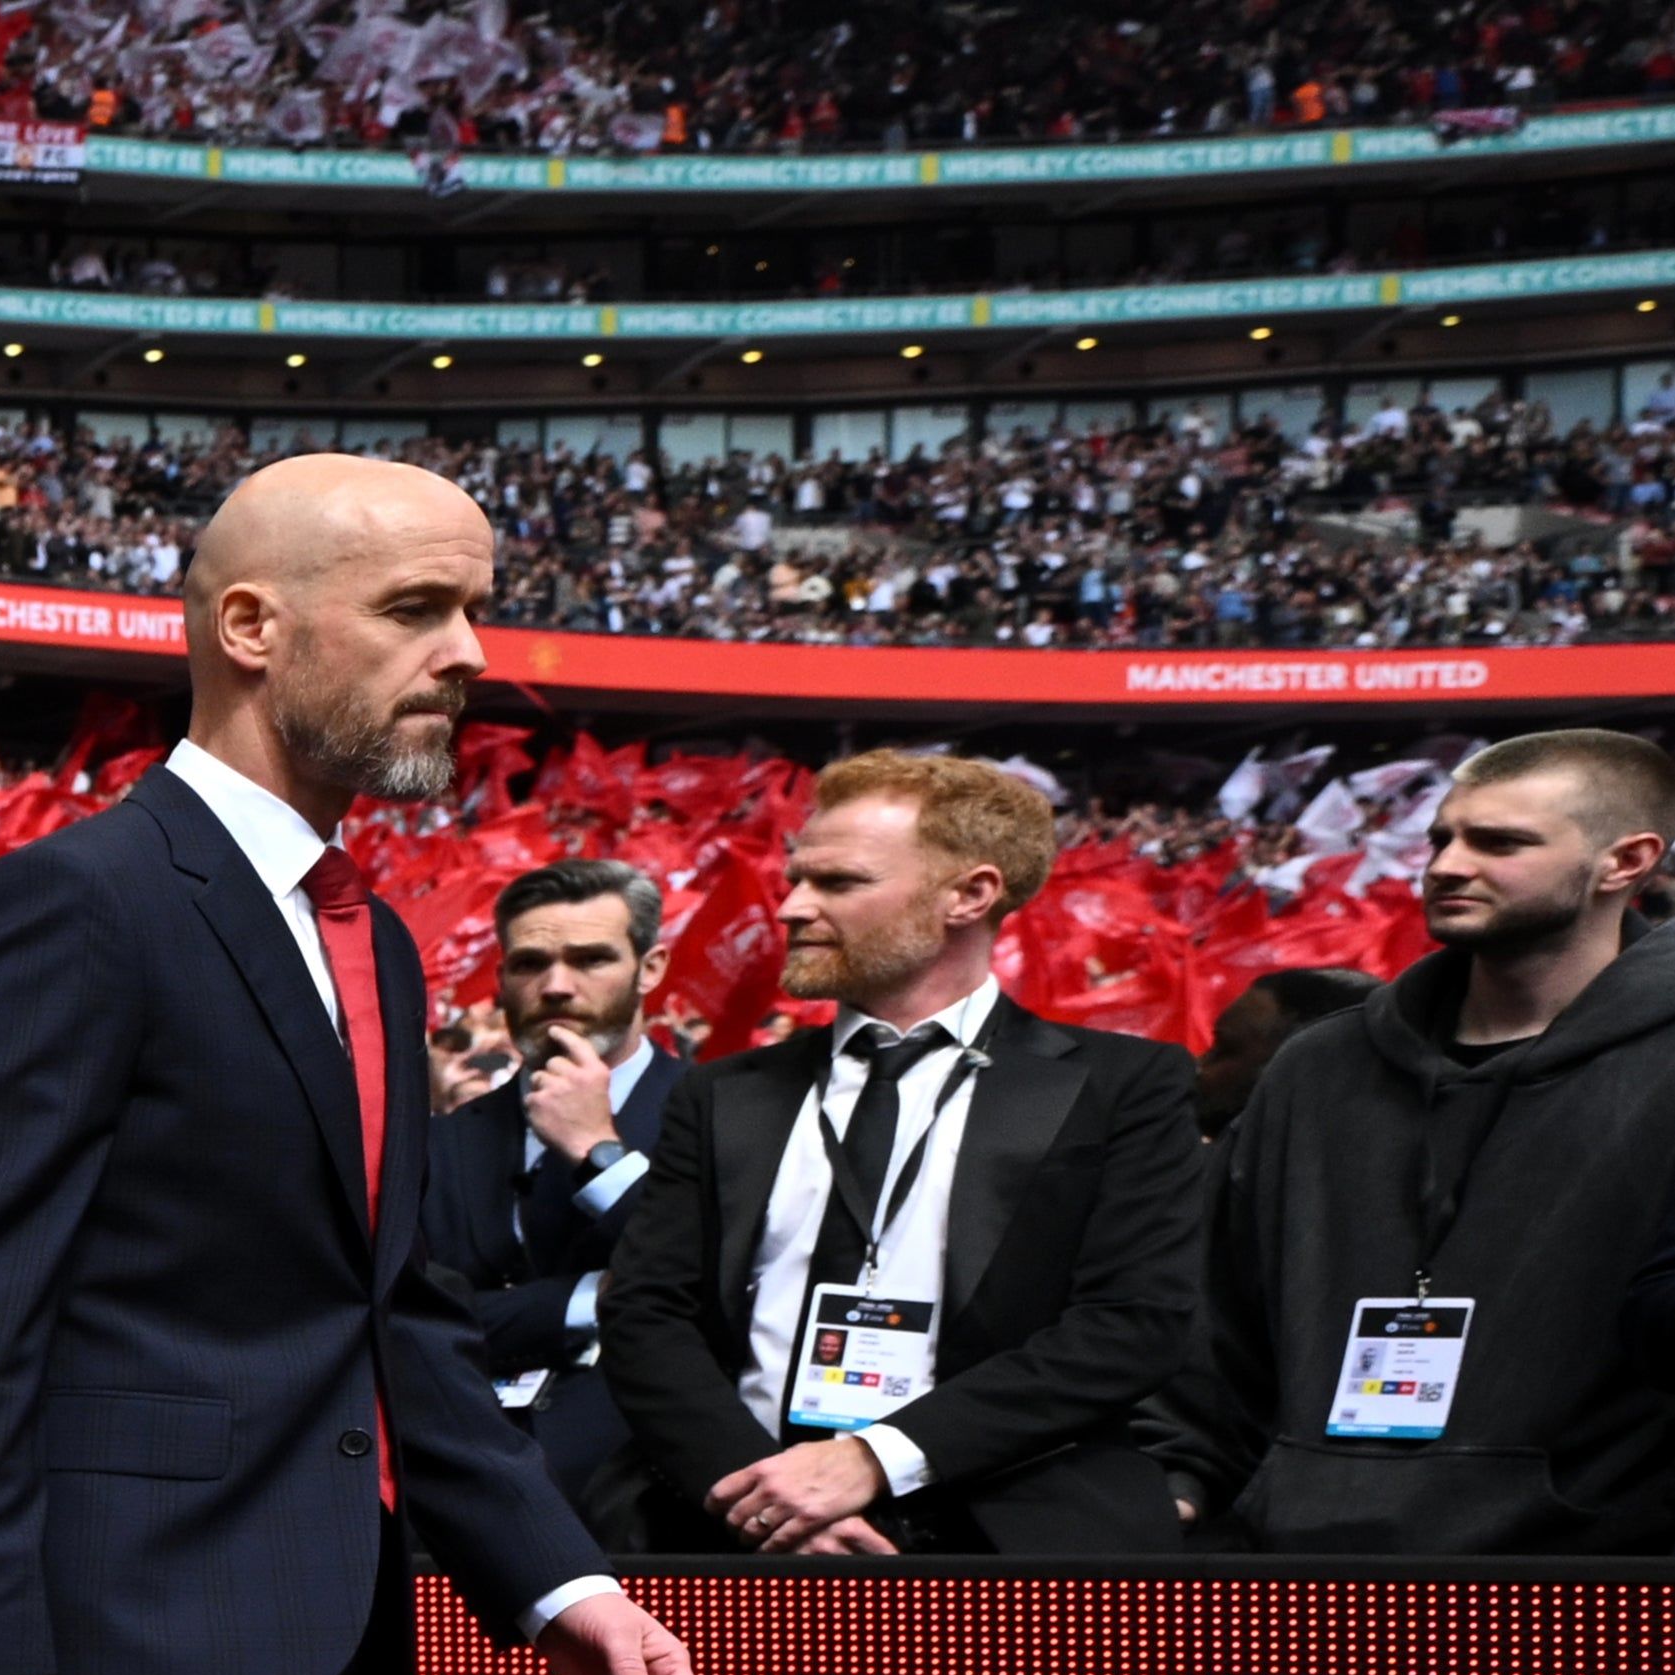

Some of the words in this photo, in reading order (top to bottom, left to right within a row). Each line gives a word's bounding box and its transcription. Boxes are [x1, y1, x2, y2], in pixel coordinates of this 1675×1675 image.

[118, 610, 184, 643] UNIT
[1126, 663, 1349, 691] MANCHESTER
[1354, 660, 1488, 690] UNITED
